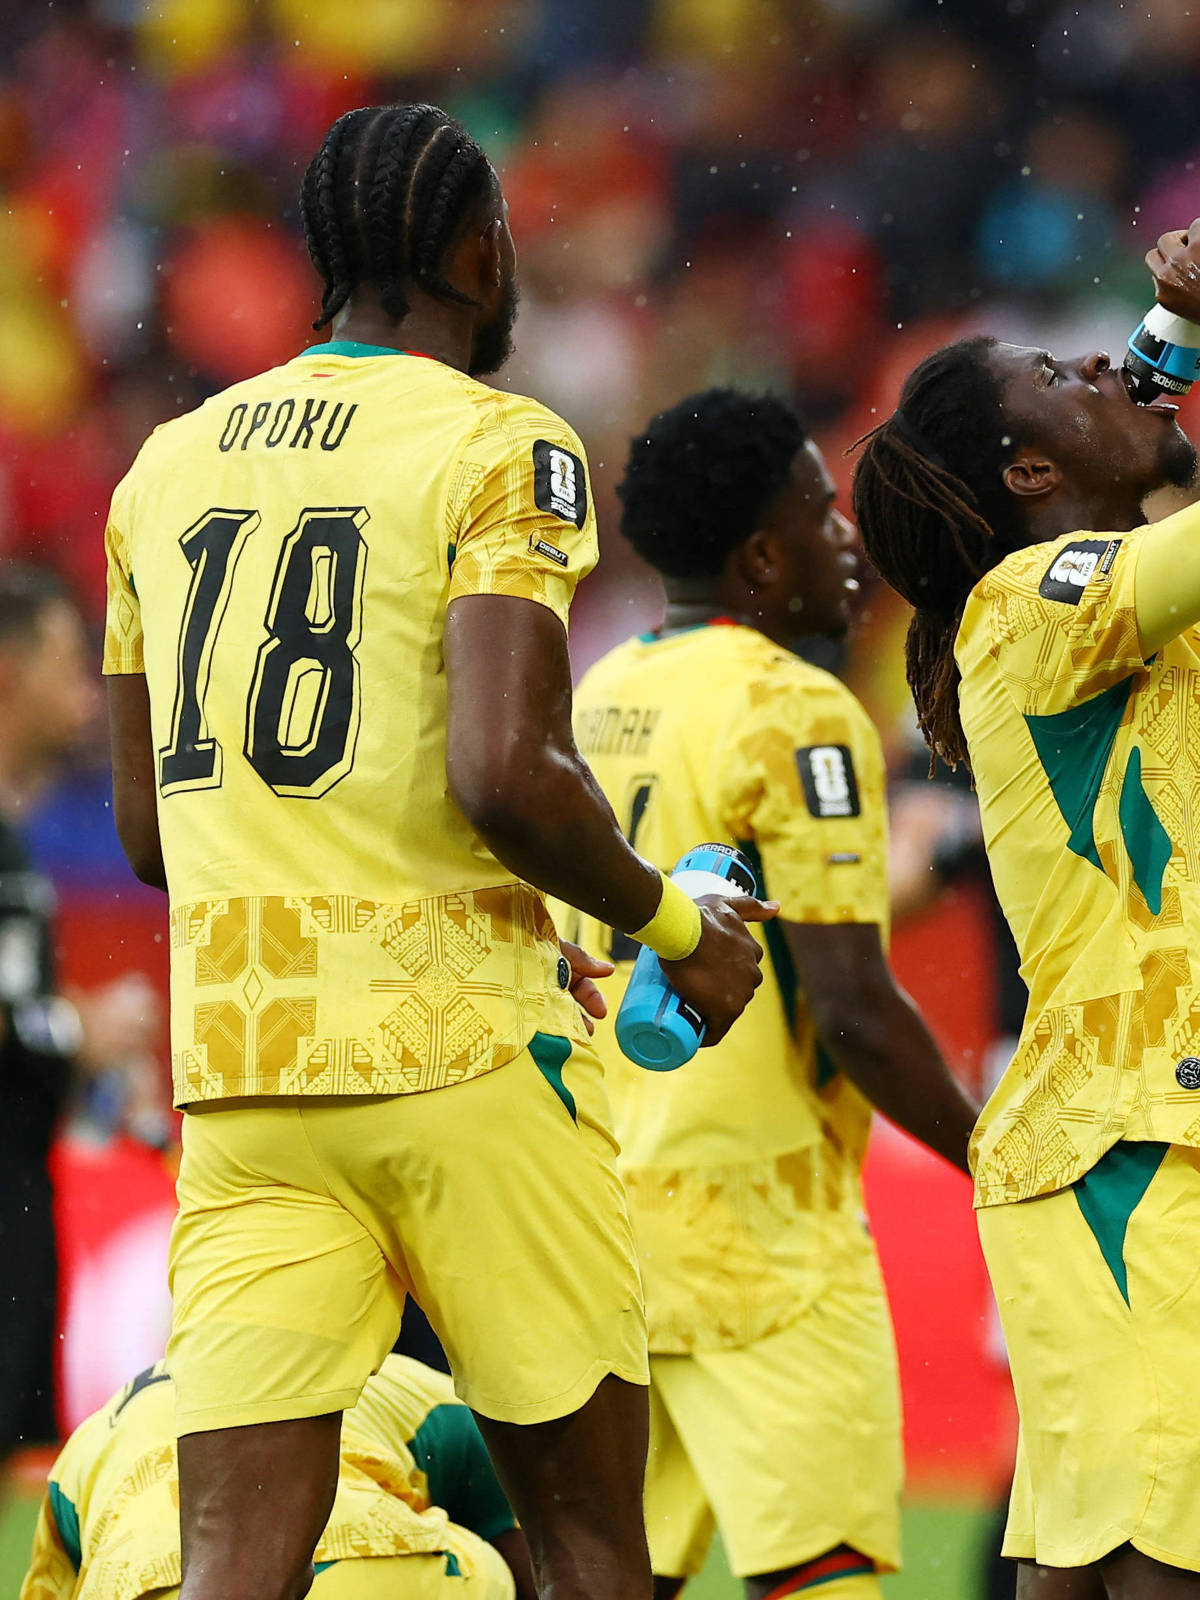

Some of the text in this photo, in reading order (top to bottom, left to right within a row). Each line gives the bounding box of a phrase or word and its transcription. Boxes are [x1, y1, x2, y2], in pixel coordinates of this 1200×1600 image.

[218, 398, 359, 452] OPOKU
[539, 541, 567, 560] DEBUT
[159, 506, 371, 800] 18
